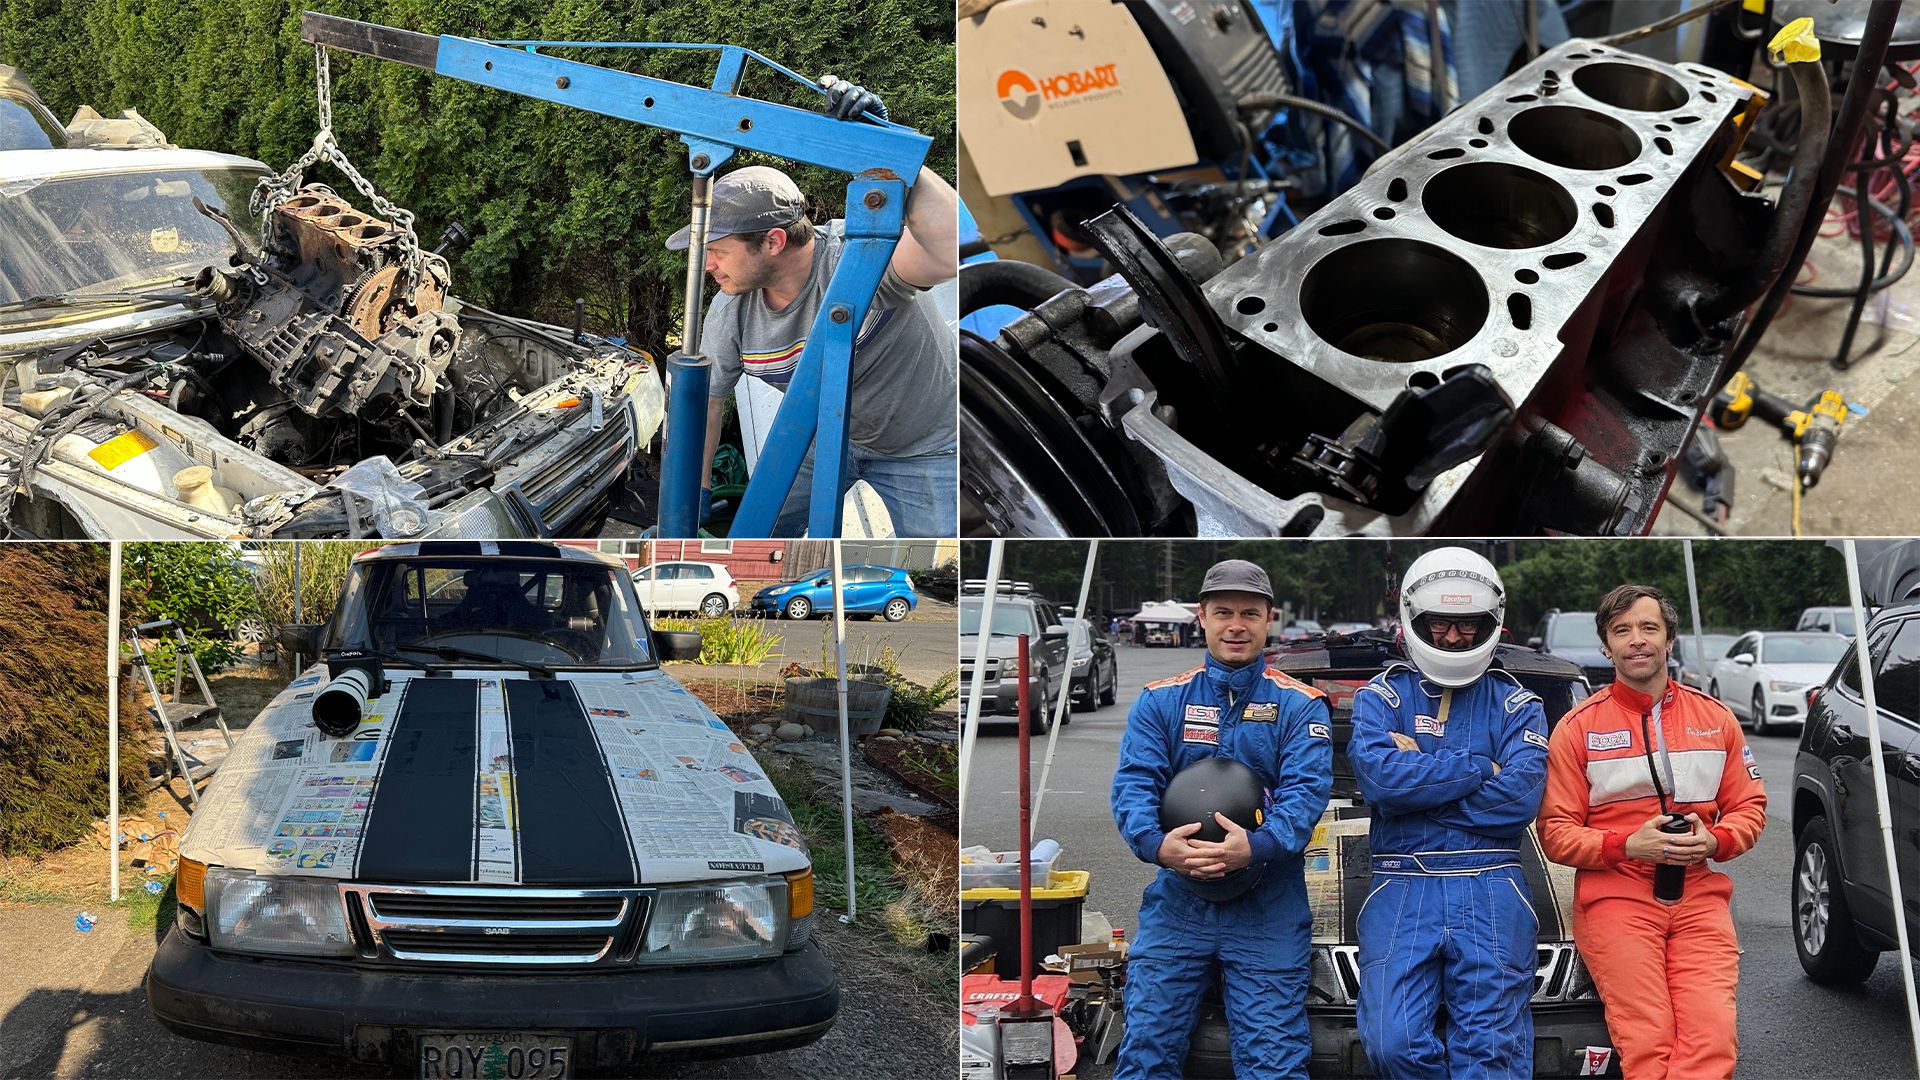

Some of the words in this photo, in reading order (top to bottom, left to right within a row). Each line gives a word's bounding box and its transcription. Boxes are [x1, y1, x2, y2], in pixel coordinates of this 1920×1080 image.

[1039, 63, 1119, 100] HOBART
[710, 862, 763, 872] TELEVISION
[485, 927, 510, 935] SAAB
[969, 992, 1043, 1001] CRAFTSN
[507, 1046, 569, 1080] 095
[1590, 1053, 1602, 1072] TOW
